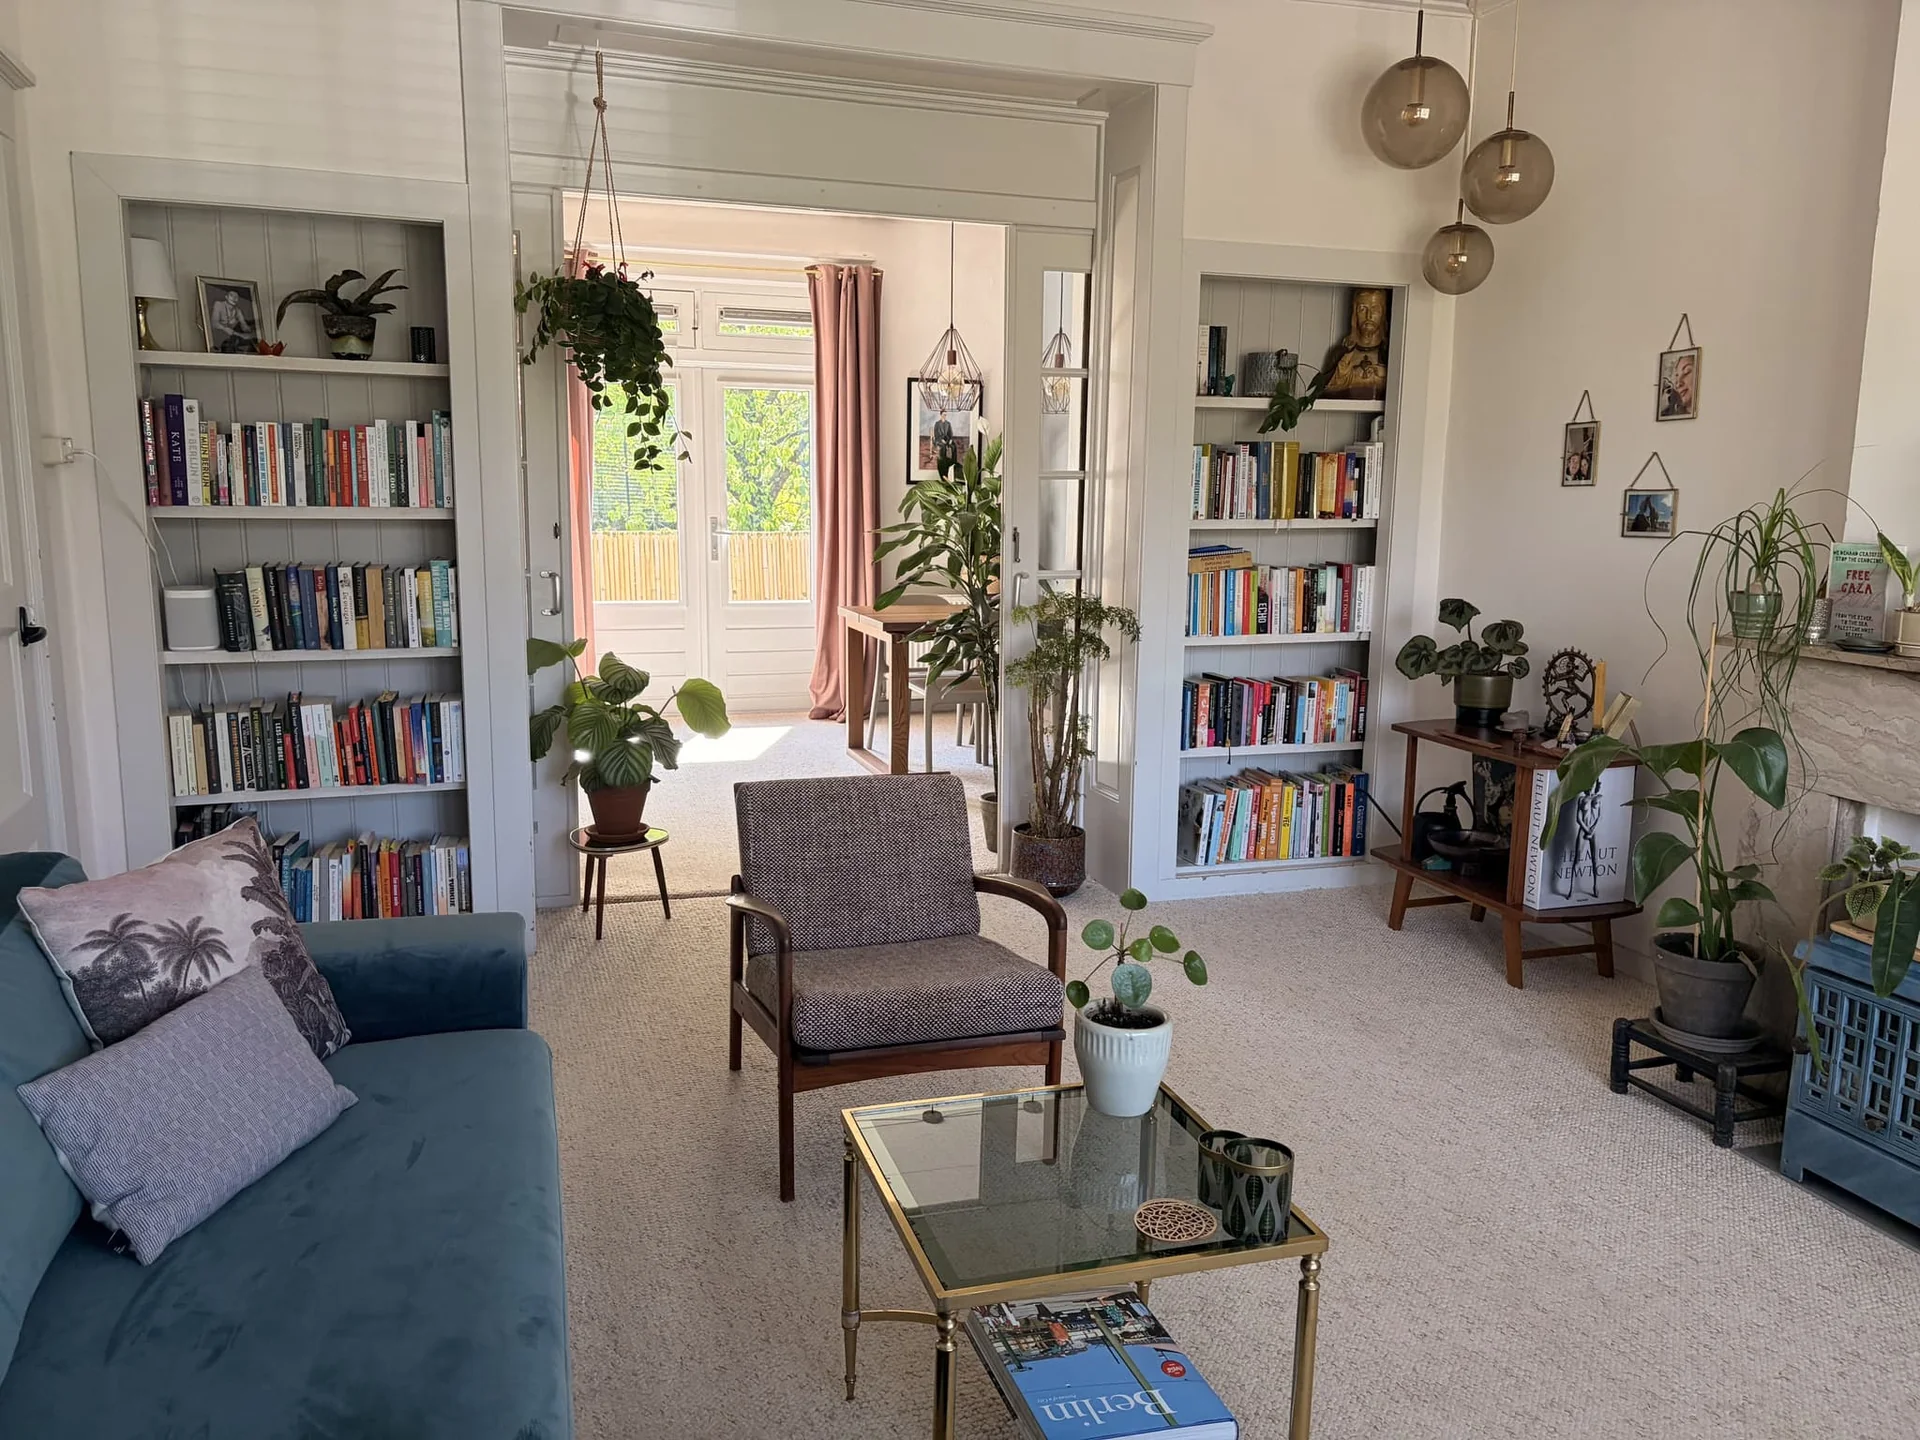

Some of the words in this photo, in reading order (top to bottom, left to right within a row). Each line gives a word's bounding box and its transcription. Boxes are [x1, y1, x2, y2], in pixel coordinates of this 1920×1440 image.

[170, 430, 181, 462] KATE
[1846, 570, 1870, 581] FREE
[1841, 582, 1872, 594] GAZA
[1257, 602, 1266, 623] ECHO
[276, 746, 284, 761] MORE
[1532, 772, 1544, 830] HELMUT
[1269, 804, 1277, 822] Vegan
[1560, 847, 1618, 864] HELMUT
[1527, 835, 1540, 898] NEWTON
[1553, 864, 1618, 880] NEWTON
[1039, 1388, 1177, 1427] Berlin
